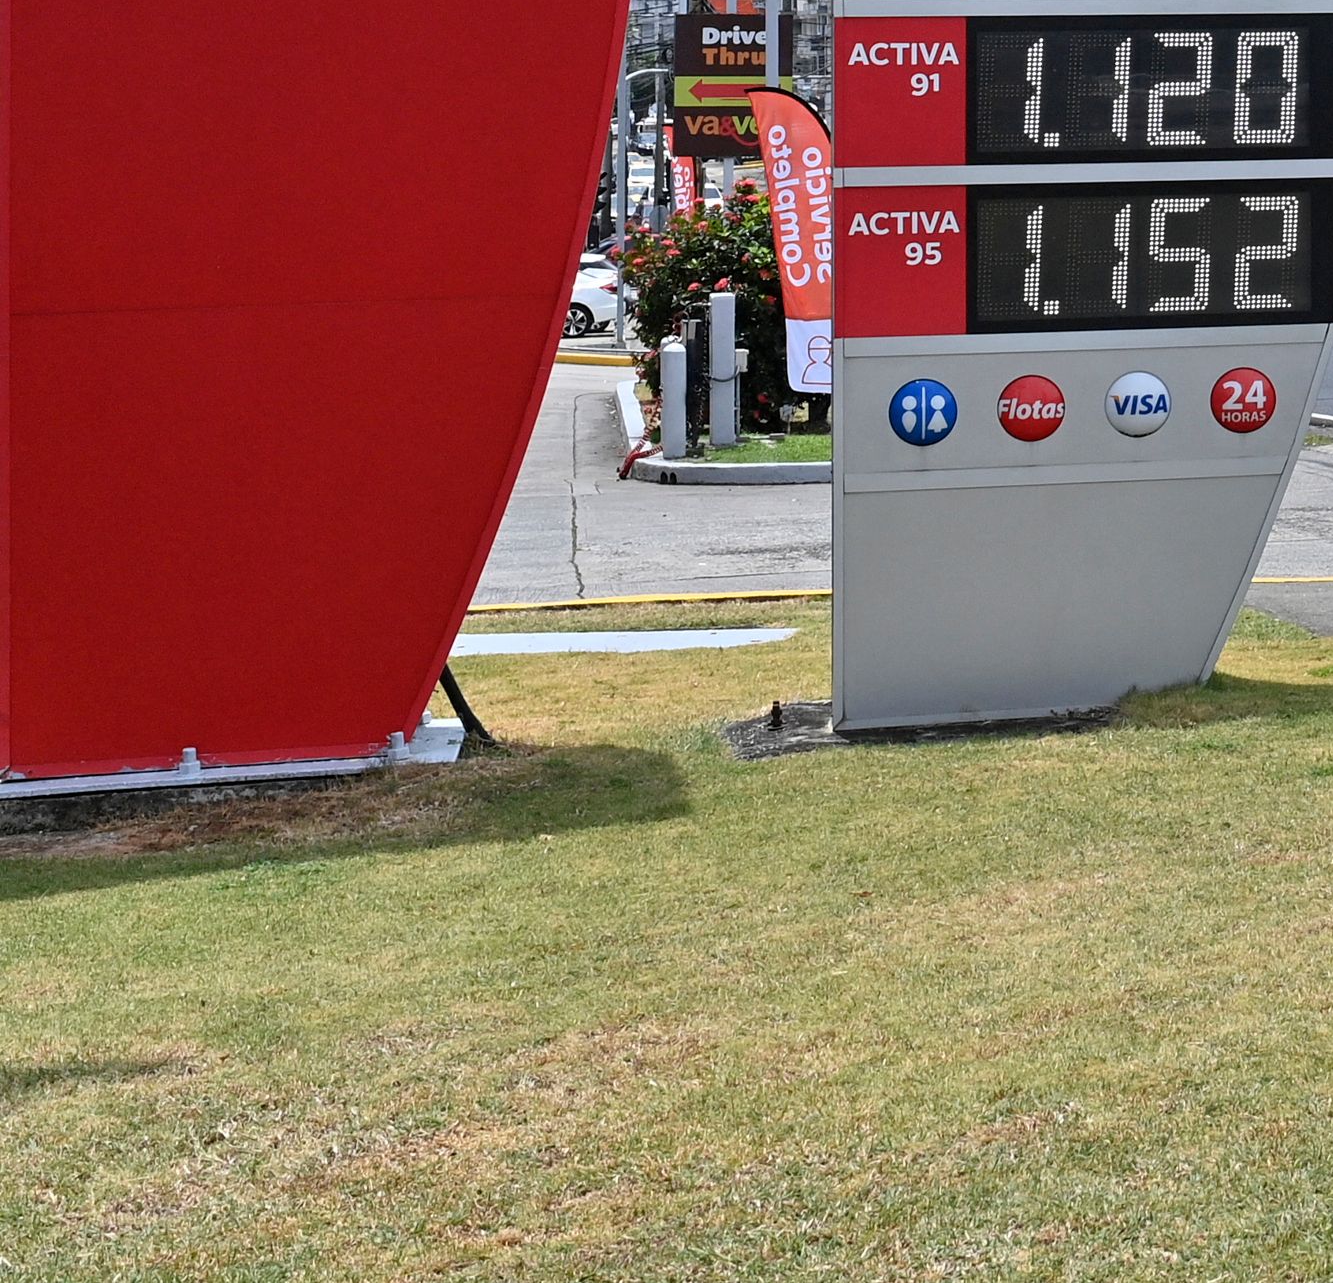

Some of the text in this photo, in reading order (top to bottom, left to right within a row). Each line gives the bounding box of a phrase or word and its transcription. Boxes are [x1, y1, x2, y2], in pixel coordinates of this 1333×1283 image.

[701, 25, 767, 46] Drive
[701, 47, 766, 66] Thru
[847, 42, 960, 66] ACTIVA
[910, 73, 940, 97] 91
[1024, 32, 1299, 147] 1.120
[684, 115, 759, 136] va&ve
[848, 210, 960, 236] ACTIVA
[904, 241, 942, 266] 95
[1024, 196, 1299, 315] 1.152
[1111, 393, 1169, 416] VISA
[1222, 379, 1267, 410] 24
[997, 398, 1066, 421] Flotas
[1220, 409, 1268, 423] HORAS
